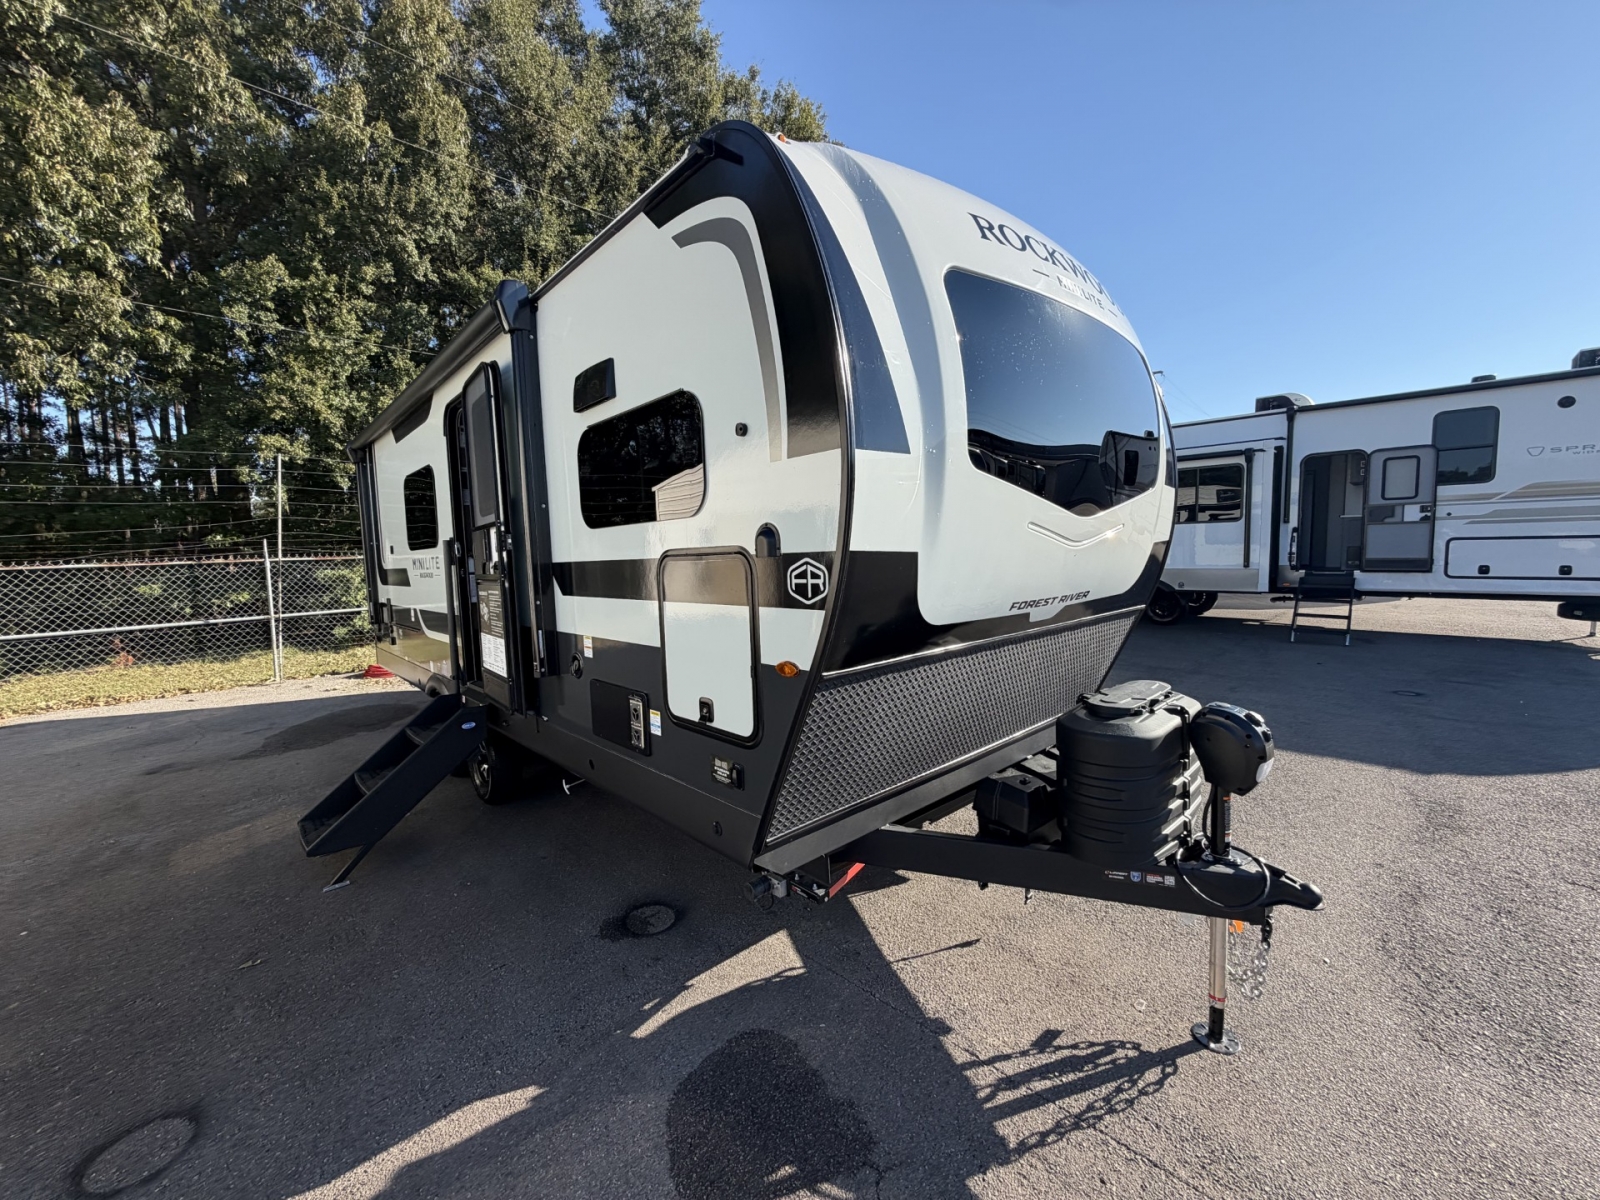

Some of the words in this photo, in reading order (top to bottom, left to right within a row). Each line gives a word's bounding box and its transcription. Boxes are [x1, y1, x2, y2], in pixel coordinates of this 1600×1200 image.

[967, 212, 1124, 315] ROCKWO
[1009, 596, 1058, 611] FOREST
[1058, 590, 1091, 604] RIVER
